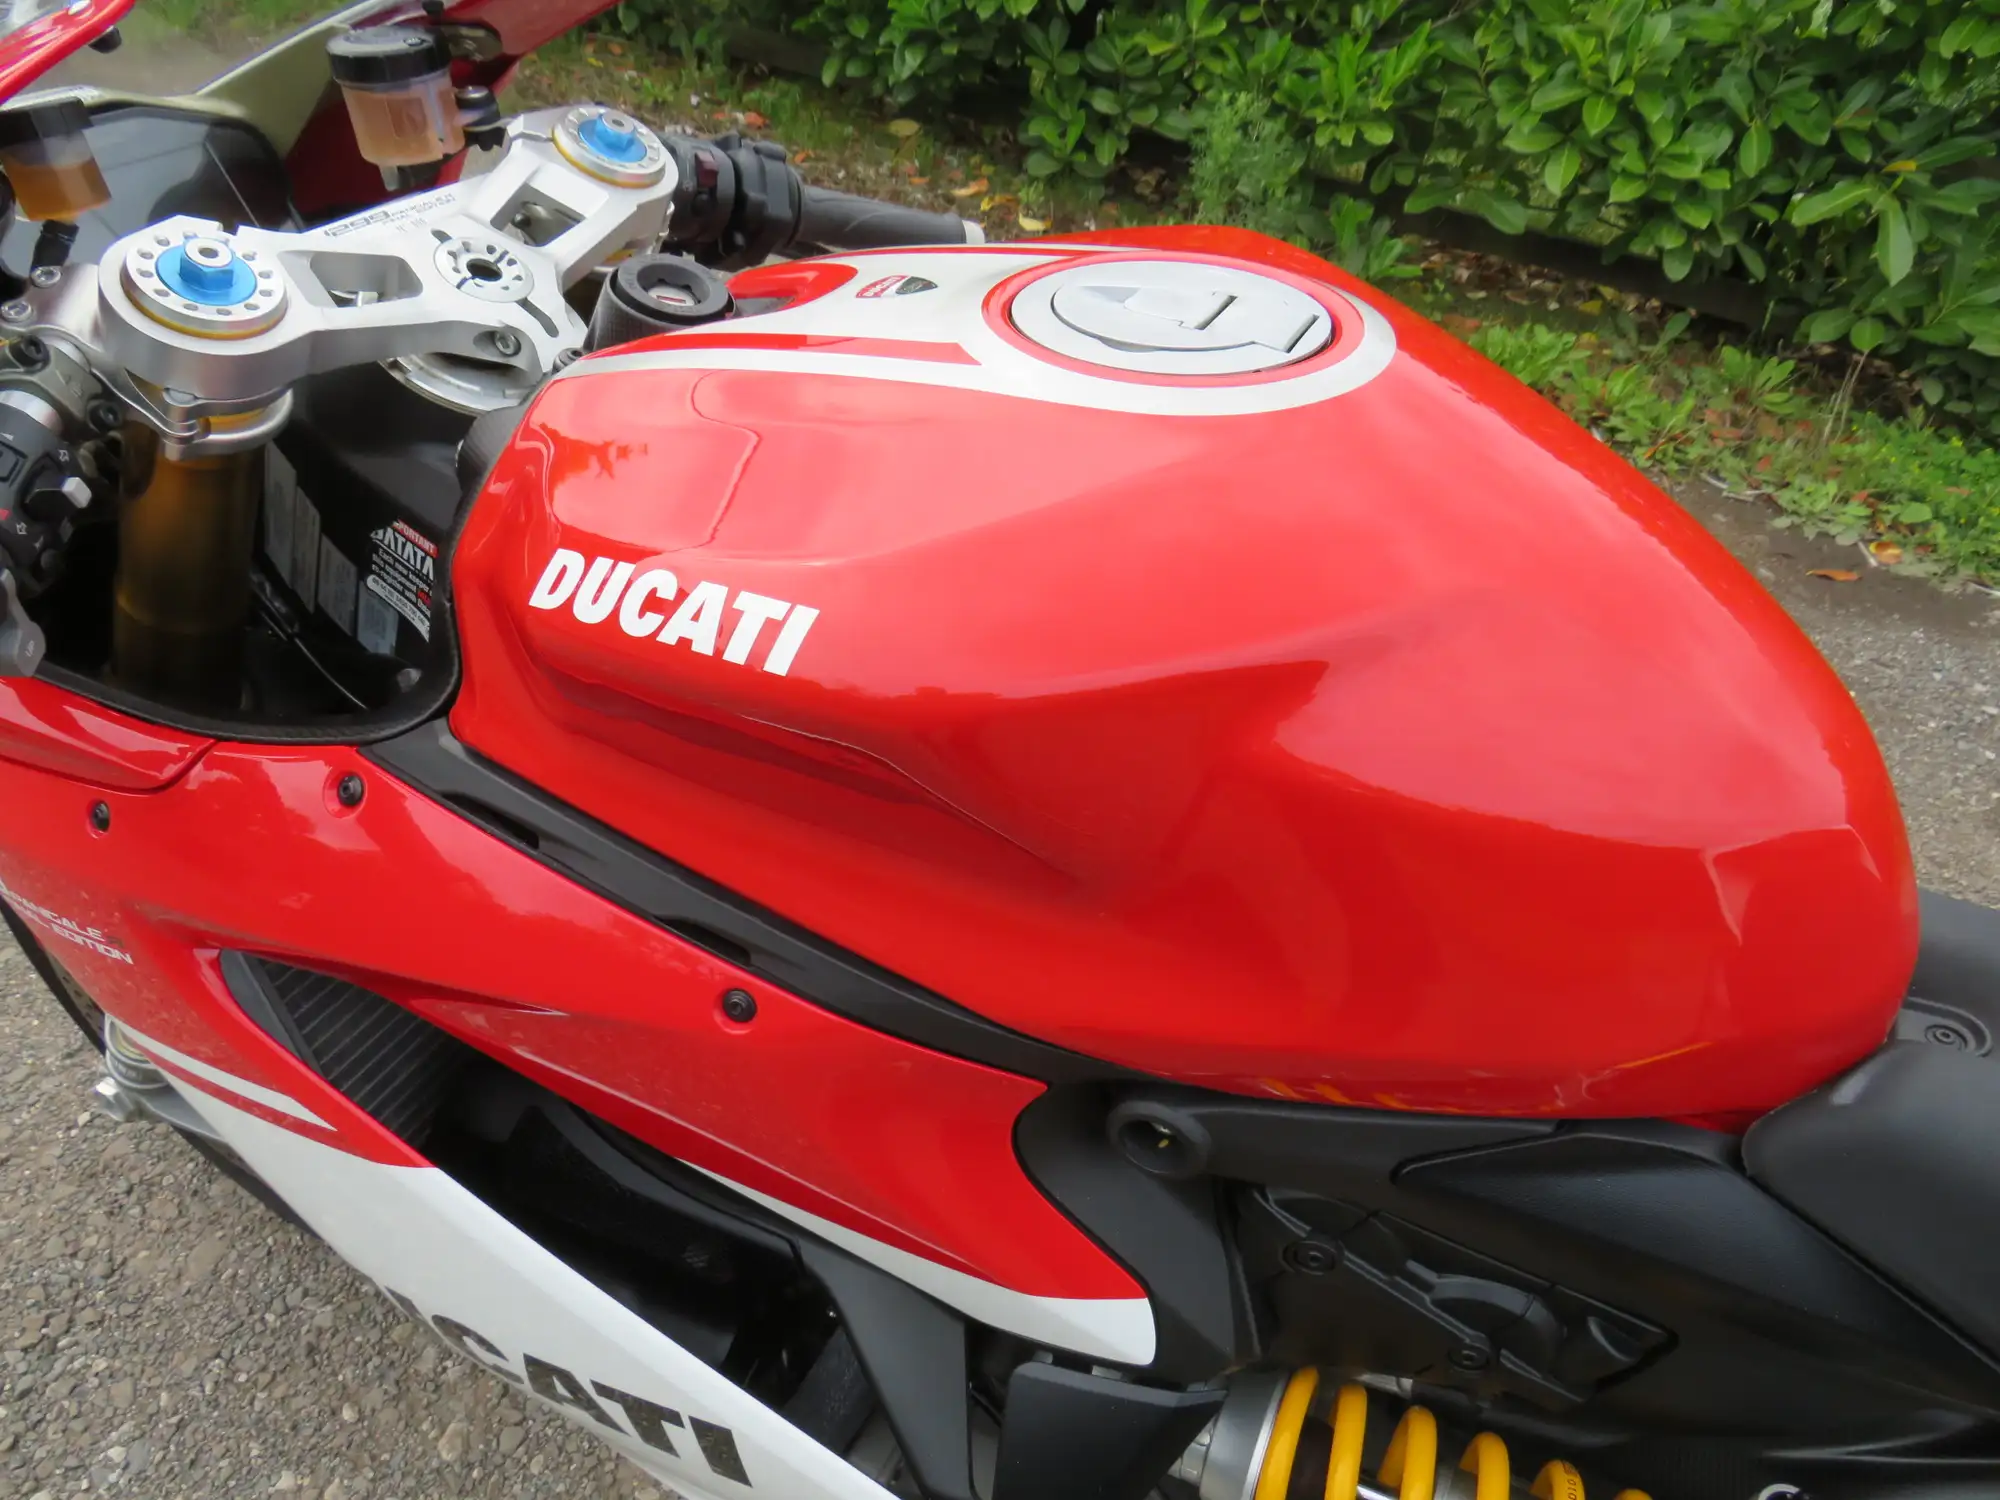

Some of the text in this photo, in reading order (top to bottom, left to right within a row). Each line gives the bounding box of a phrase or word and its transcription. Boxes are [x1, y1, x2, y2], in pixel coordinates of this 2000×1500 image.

[371, 527, 434, 581] DATATA
[393, 521, 434, 553] PORTANT
[529, 548, 820, 677] DUCATI
[51, 923, 134, 965] EDITION
[384, 1285, 754, 1488] CATI
